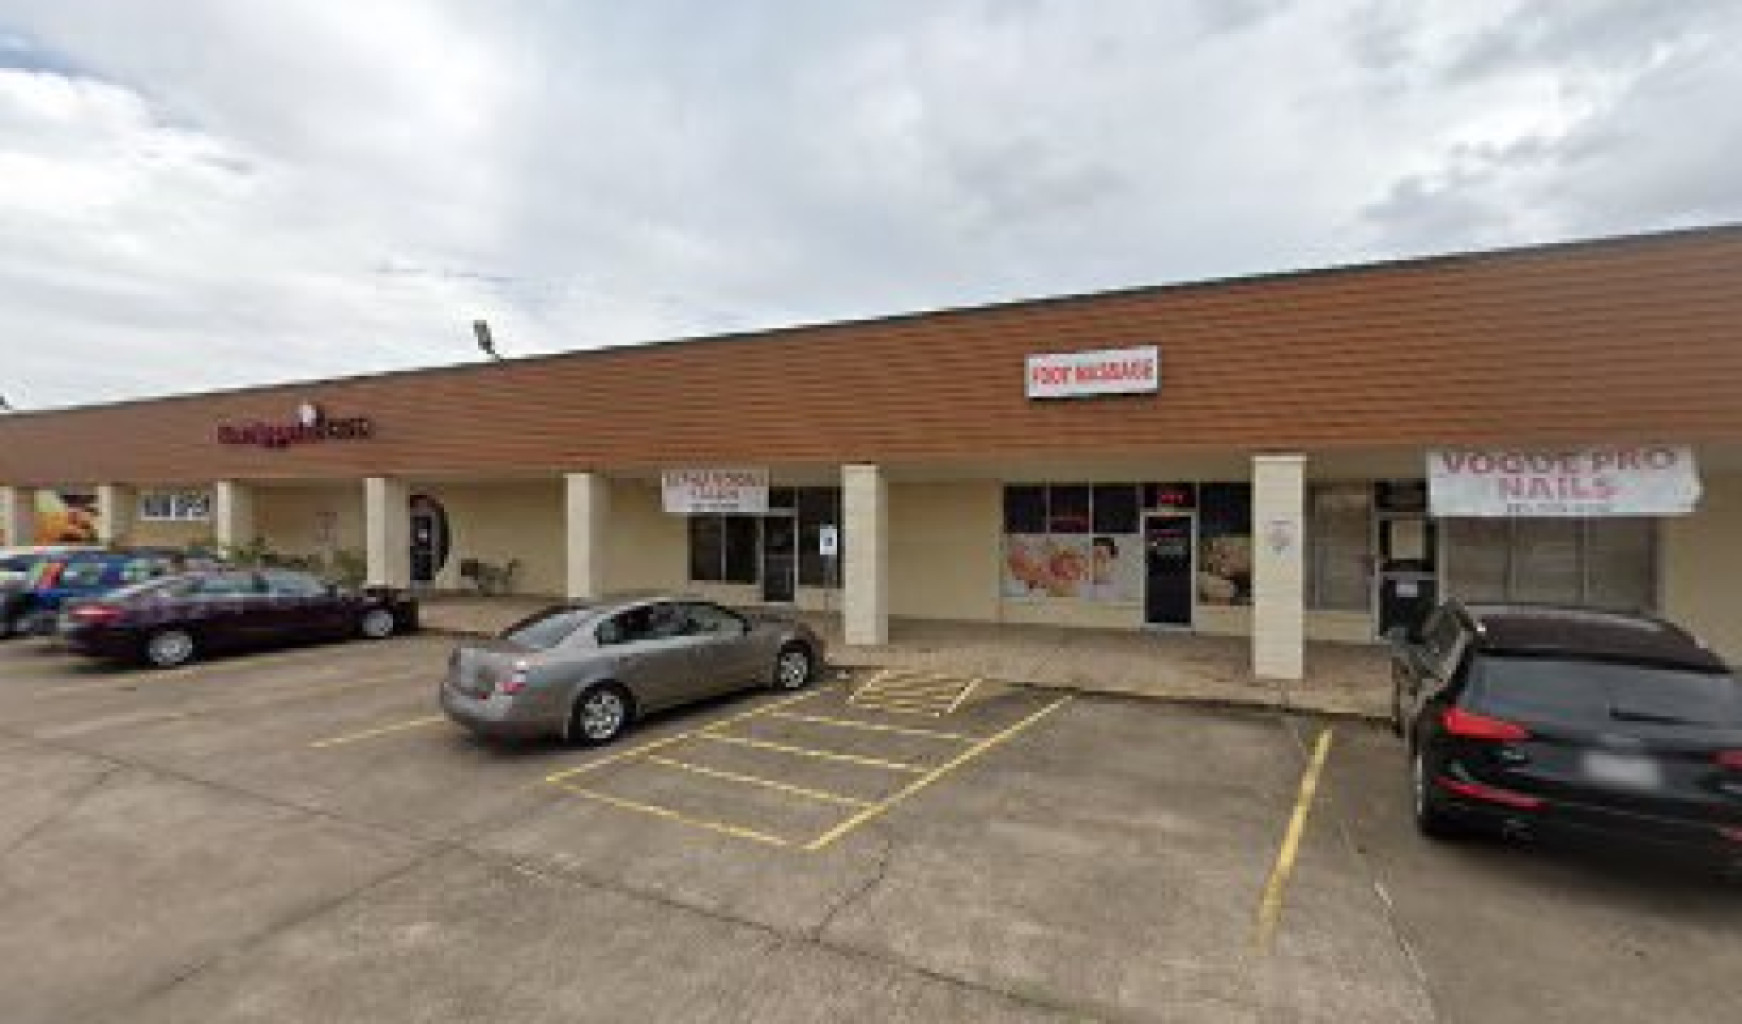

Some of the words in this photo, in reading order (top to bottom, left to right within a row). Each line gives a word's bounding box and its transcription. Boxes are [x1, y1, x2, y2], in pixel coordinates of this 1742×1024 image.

[1032, 365, 1072, 385] FOOT
[1075, 358, 1154, 382] MASSAGE
[1442, 449, 1578, 475] VOGUE
[1592, 446, 1677, 471] PRO
[1498, 476, 1614, 501] NAILS
